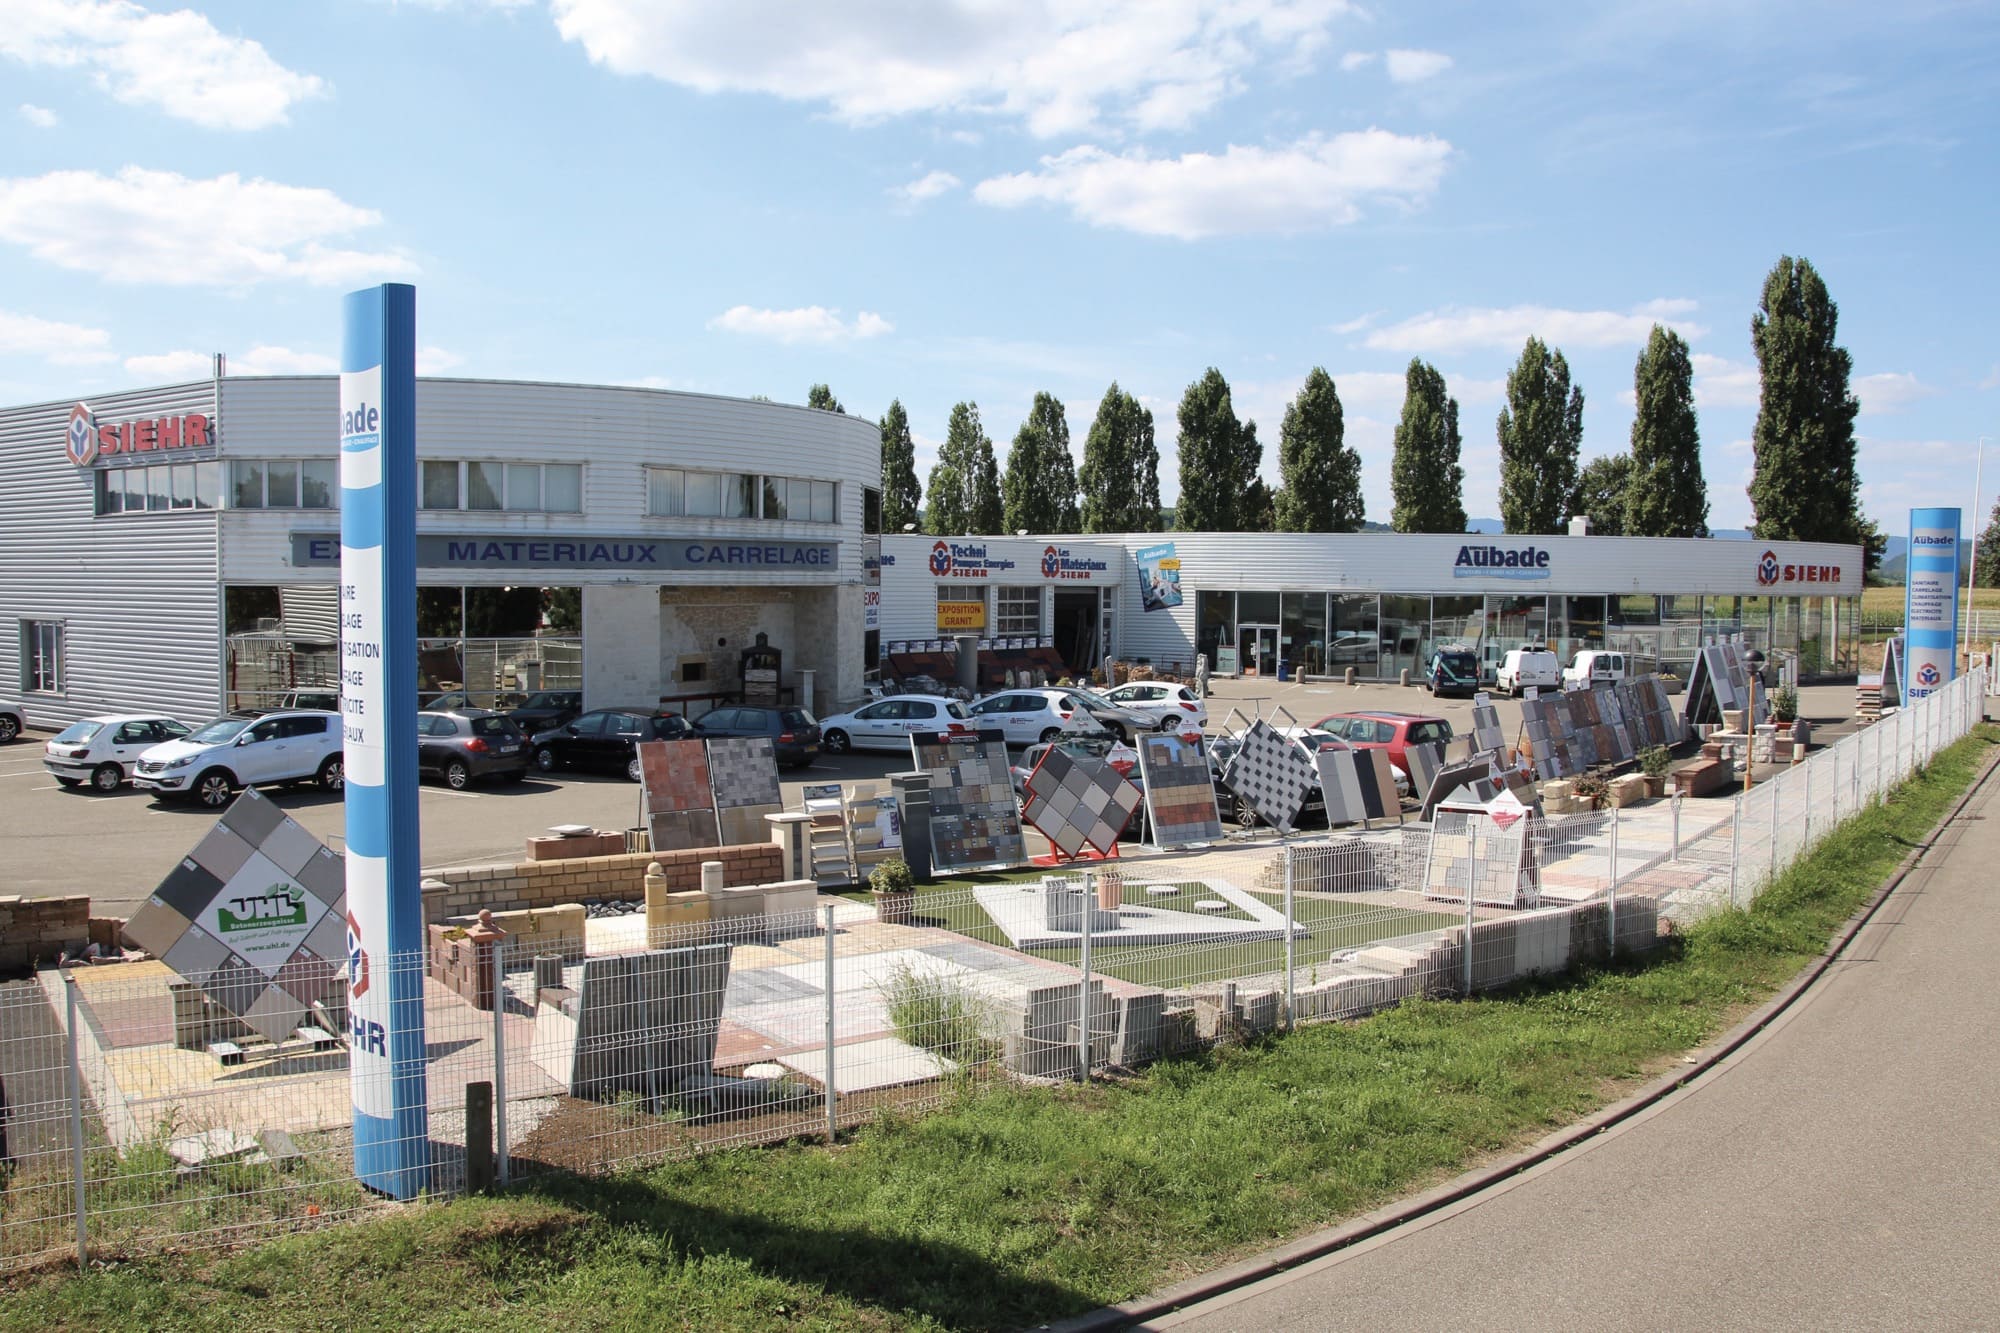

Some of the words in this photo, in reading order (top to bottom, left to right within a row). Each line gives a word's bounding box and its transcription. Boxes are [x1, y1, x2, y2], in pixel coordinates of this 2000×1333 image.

[342, 402, 379, 434] ade
[98, 414, 209, 455] SIEHR
[448, 541, 657, 563] MATERIAUX
[685, 544, 830, 565] CARRELAGE
[950, 543, 987, 558] Techni
[1455, 545, 1550, 568] Aubade
[951, 568, 988, 578] SIEHR
[1060, 570, 1090, 579] SIEHR
[1783, 564, 1841, 583] SIEHR
[864, 591, 880, 606] EXPO
[937, 604, 981, 614] EXPOSITION
[944, 616, 973, 625] GRANIT
[350, 1010, 386, 1057] HR
